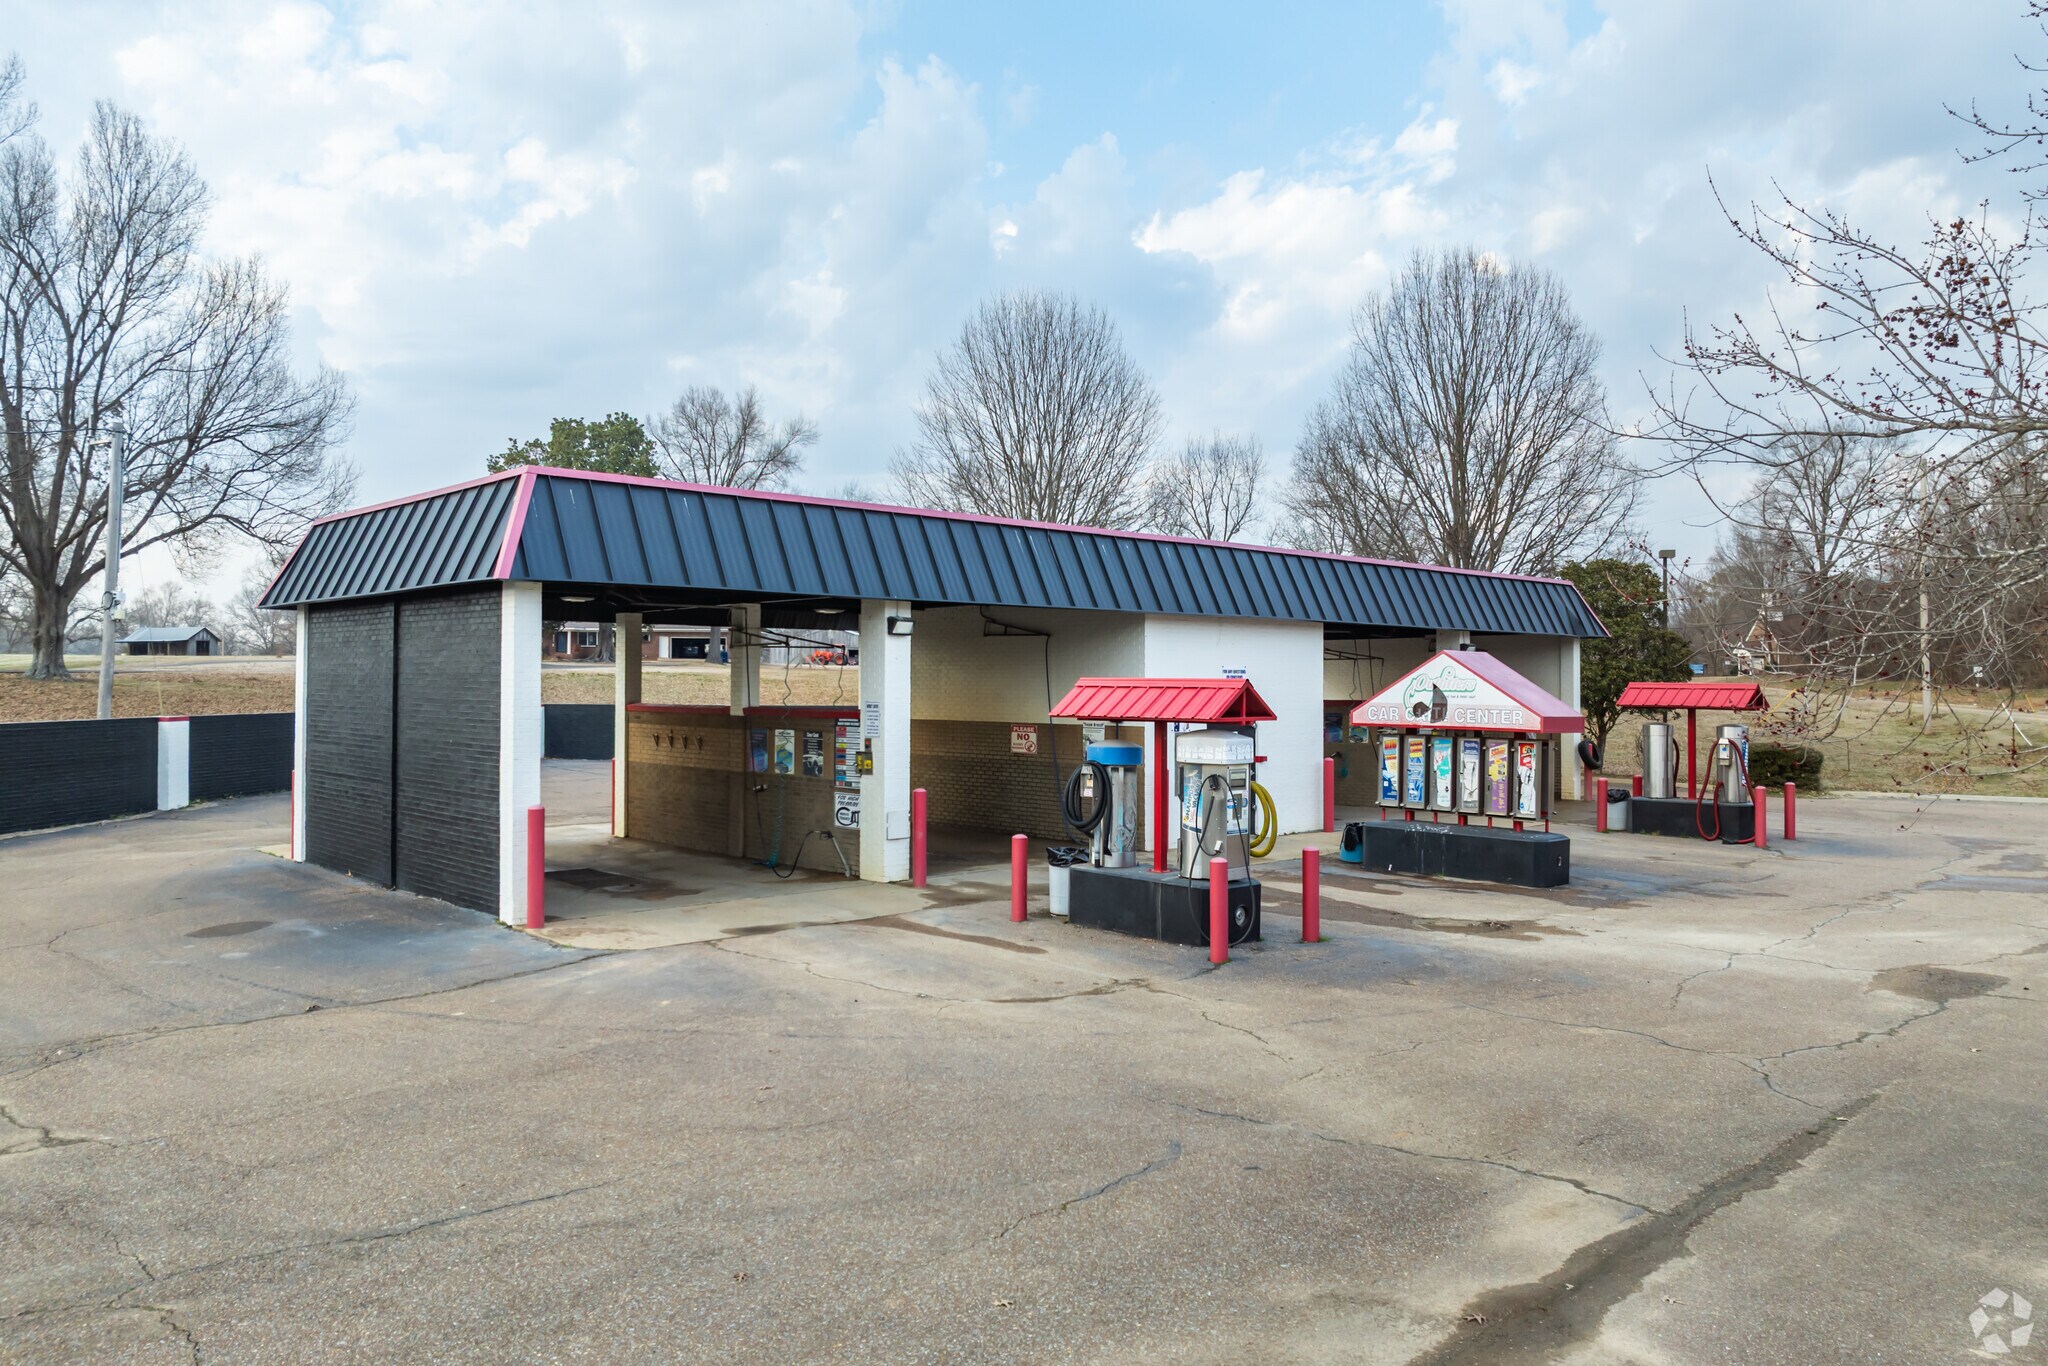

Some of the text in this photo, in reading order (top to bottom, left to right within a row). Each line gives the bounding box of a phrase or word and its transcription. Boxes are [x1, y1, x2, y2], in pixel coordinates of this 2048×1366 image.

[1367, 706, 1399, 721] CAR
[1454, 708, 1524, 725] CENTER
[1017, 733, 1030, 741] NO
